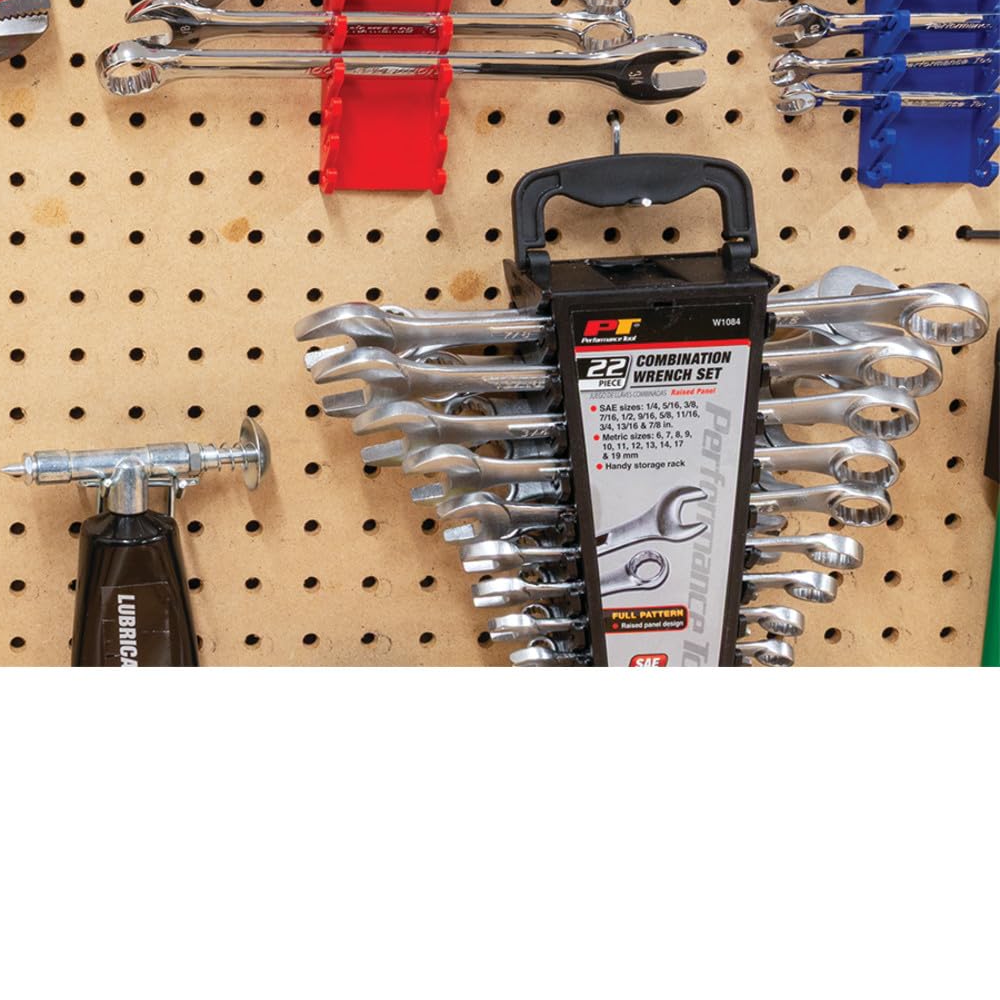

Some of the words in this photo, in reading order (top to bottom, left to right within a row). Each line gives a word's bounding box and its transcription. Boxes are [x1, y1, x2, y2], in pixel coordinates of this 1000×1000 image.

[712, 318, 741, 326] W1084
[583, 318, 642, 337] PT
[636, 351, 732, 367] COMBINATION
[587, 359, 627, 378] 22
[633, 368, 695, 383] WRENCH
[696, 368, 722, 380] SET
[598, 379, 621, 387] PIECE
[600, 404, 617, 412] SAE
[638, 412, 657, 420] 9/16,
[660, 411, 673, 419] 5/8,
[677, 410, 700, 418] 11/16,
[600, 423, 614, 431] 3/4,
[617, 422, 638, 430] 13/16
[663, 420, 673, 428] in.
[656, 431, 664, 439] 6,
[666, 431, 673, 439] 7,
[675, 431, 682, 439] 8,
[685, 430, 692, 438] 9,
[603, 443, 614, 451] 10,
[646, 441, 657, 449] 13,
[606, 462, 631, 470] Handy
[634, 461, 665, 469] storage
[688, 401, 732, 635] Performance
[640, 609, 684, 618] PATTERN
